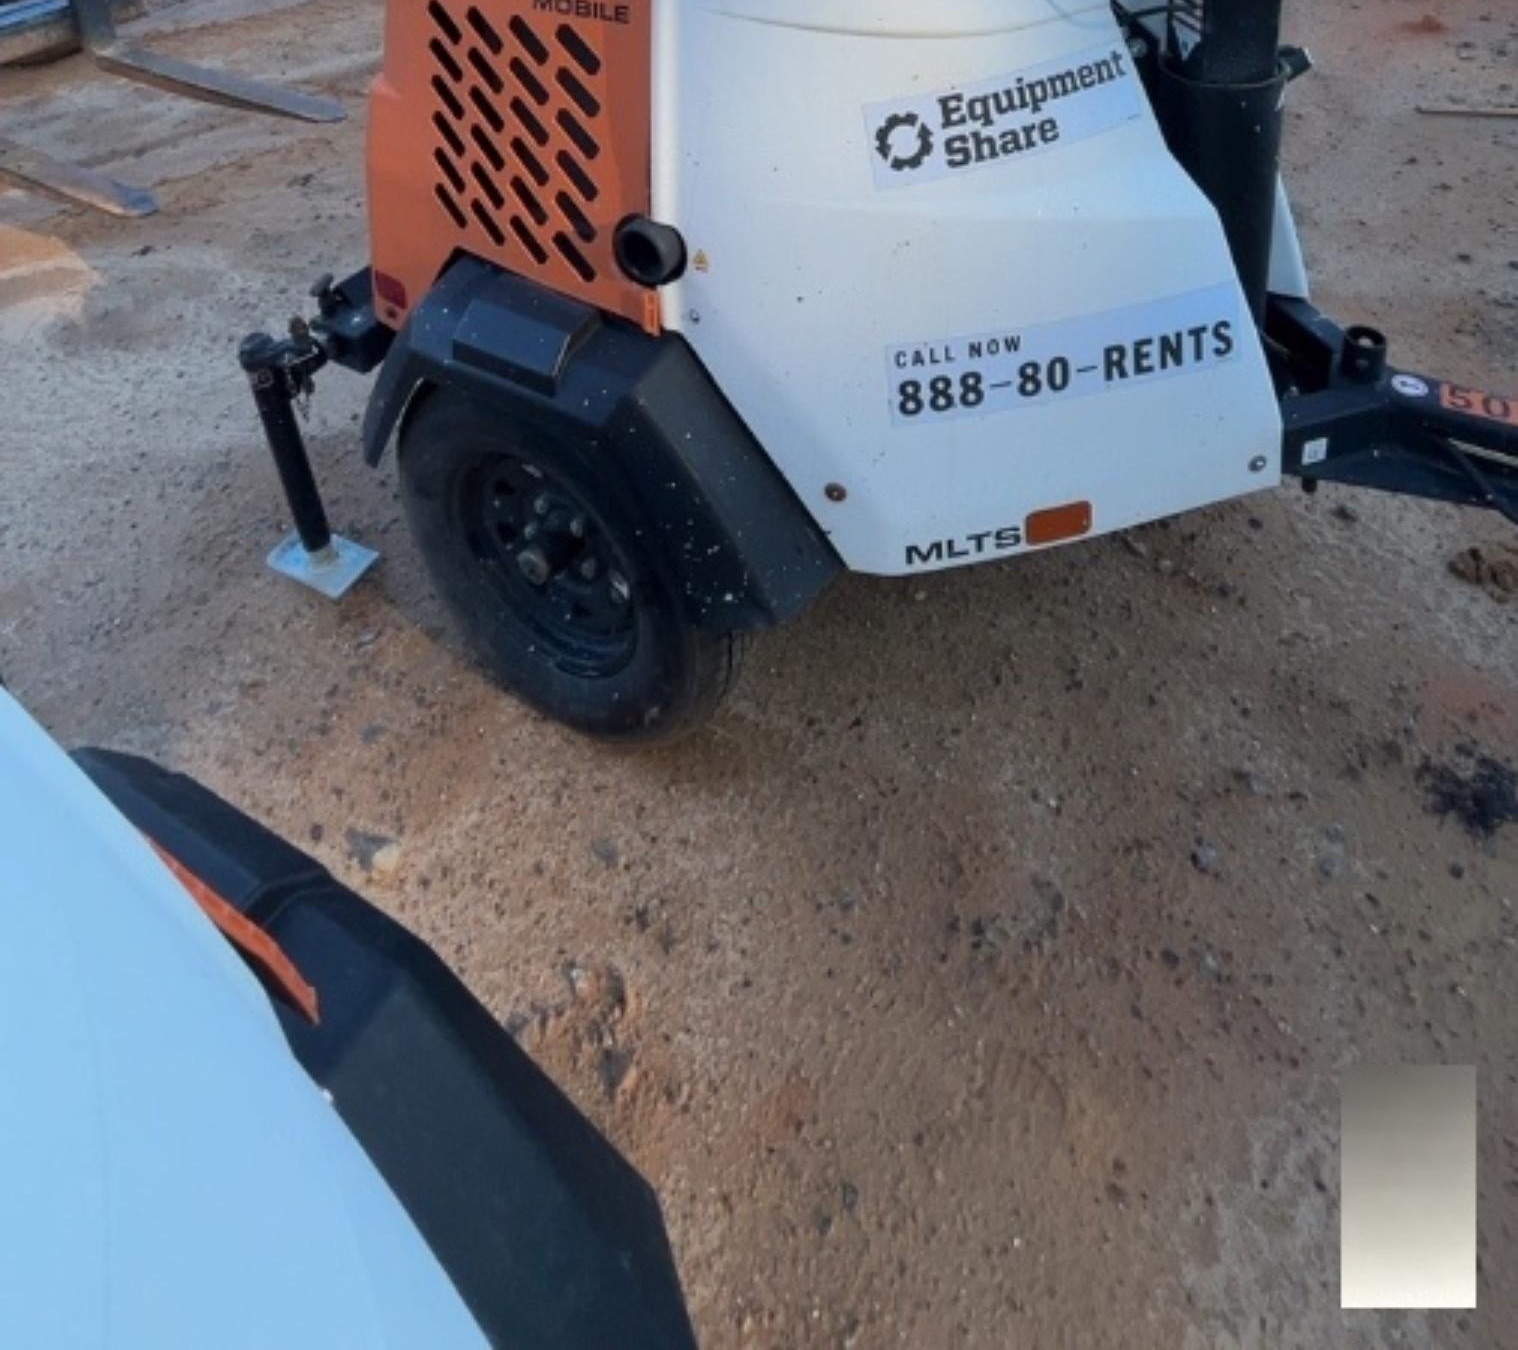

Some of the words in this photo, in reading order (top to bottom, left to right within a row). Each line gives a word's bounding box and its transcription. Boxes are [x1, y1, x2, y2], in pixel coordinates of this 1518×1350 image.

[937, 50, 1126, 129] Equipment
[944, 117, 1060, 168] Share
[894, 345, 955, 369] CALL
[969, 335, 1022, 359] NOW
[905, 526, 1021, 565] MLTS
